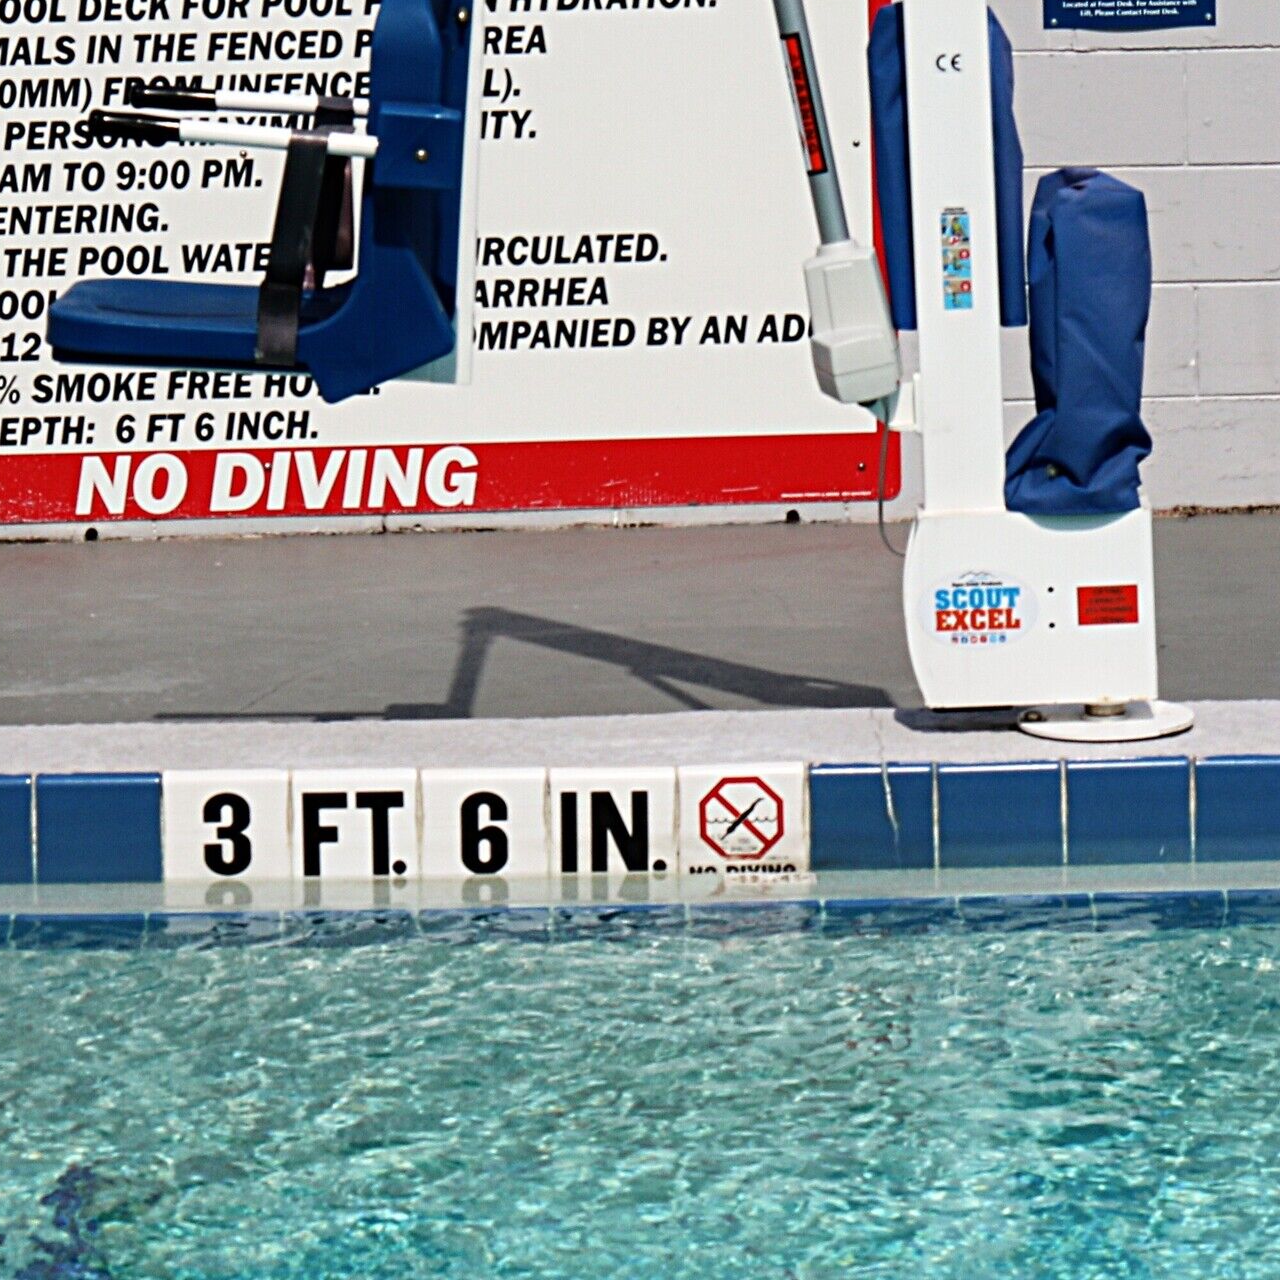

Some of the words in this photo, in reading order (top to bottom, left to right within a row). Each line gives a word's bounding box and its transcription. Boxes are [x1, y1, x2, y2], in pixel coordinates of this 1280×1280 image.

[87, 35, 121, 64] IN
[134, 33, 197, 62] THE
[208, 30, 342, 61] FENCED
[217, 71, 370, 104] UNFENCE
[64, 162, 105, 191] TO
[117, 160, 190, 190] 9:00
[202, 158, 263, 188] PM.
[5, 248, 68, 277] THE
[78, 246, 168, 275] POOL
[182, 243, 271, 273] WATE
[0, 333, 41, 361] 12
[647, 317, 691, 345] BY
[700, 315, 748, 344] AN
[32, 372, 157, 403] SMOKE
[167, 370, 252, 401] FREE
[116, 415, 135, 443] 6
[147, 414, 185, 442] FT
[195, 413, 214, 441] 6
[226, 411, 318, 440] INCH.
[75, 452, 188, 516] NO
[210, 445, 479, 512] DIVING
[935, 587, 1020, 609] SCOUT
[936, 607, 1020, 631] EXCEL
[202, 792, 252, 876] 3
[301, 790, 407, 877] FT.
[459, 791, 509, 876] 6
[560, 790, 668, 874] IN.
